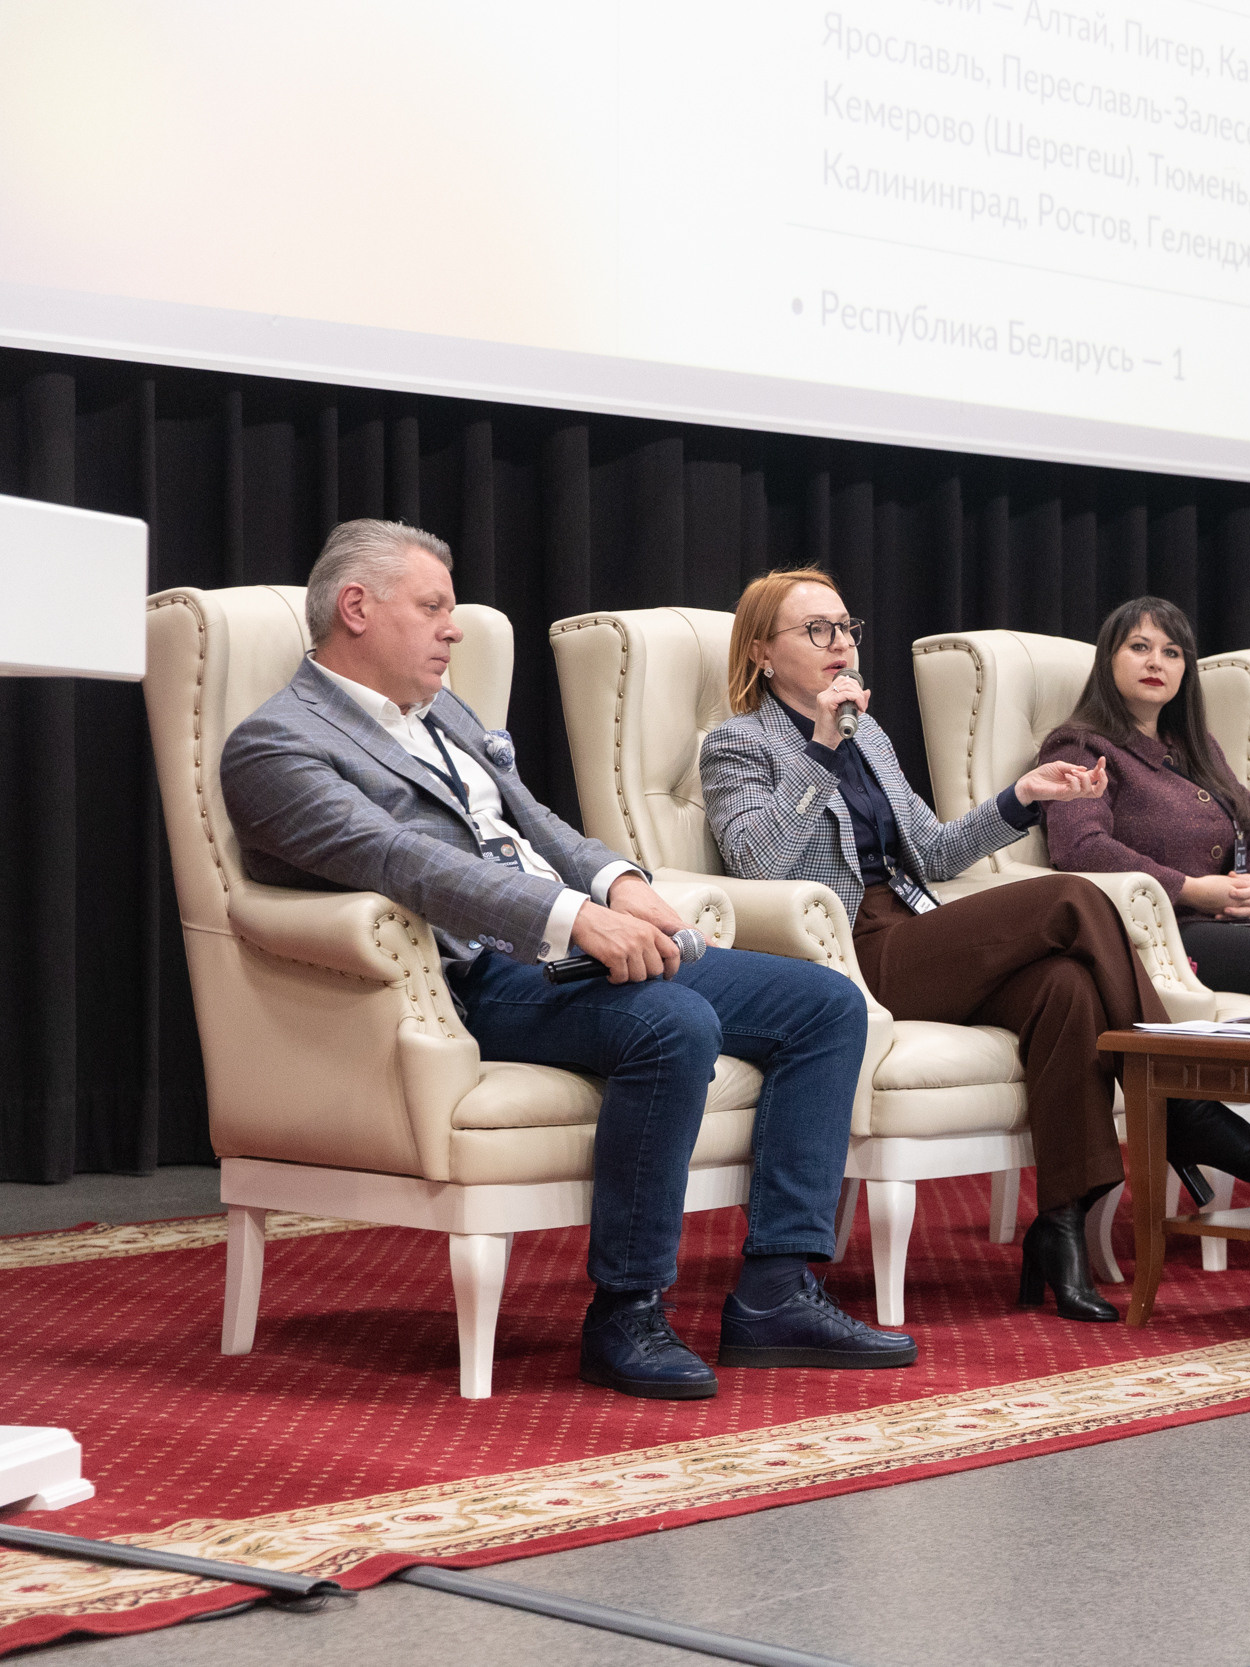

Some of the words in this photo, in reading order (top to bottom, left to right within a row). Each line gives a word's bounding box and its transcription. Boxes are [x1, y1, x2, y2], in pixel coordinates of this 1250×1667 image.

[821, 11, 992, 89] Ярославль,
[1023, 0, 1116, 52] Алтай,
[1124, 18, 1211, 77] Питер,
[823, 79, 975, 147] Кемерово
[984, 113, 1140, 187] (Шерегеш),
[823, 148, 1028, 231] Калининград,
[1038, 192, 1138, 248] Ростов,
[820, 288, 998, 352] Республика
[1008, 319, 1135, 374] Беларусь
[1172, 346, 1186, 382] 1
